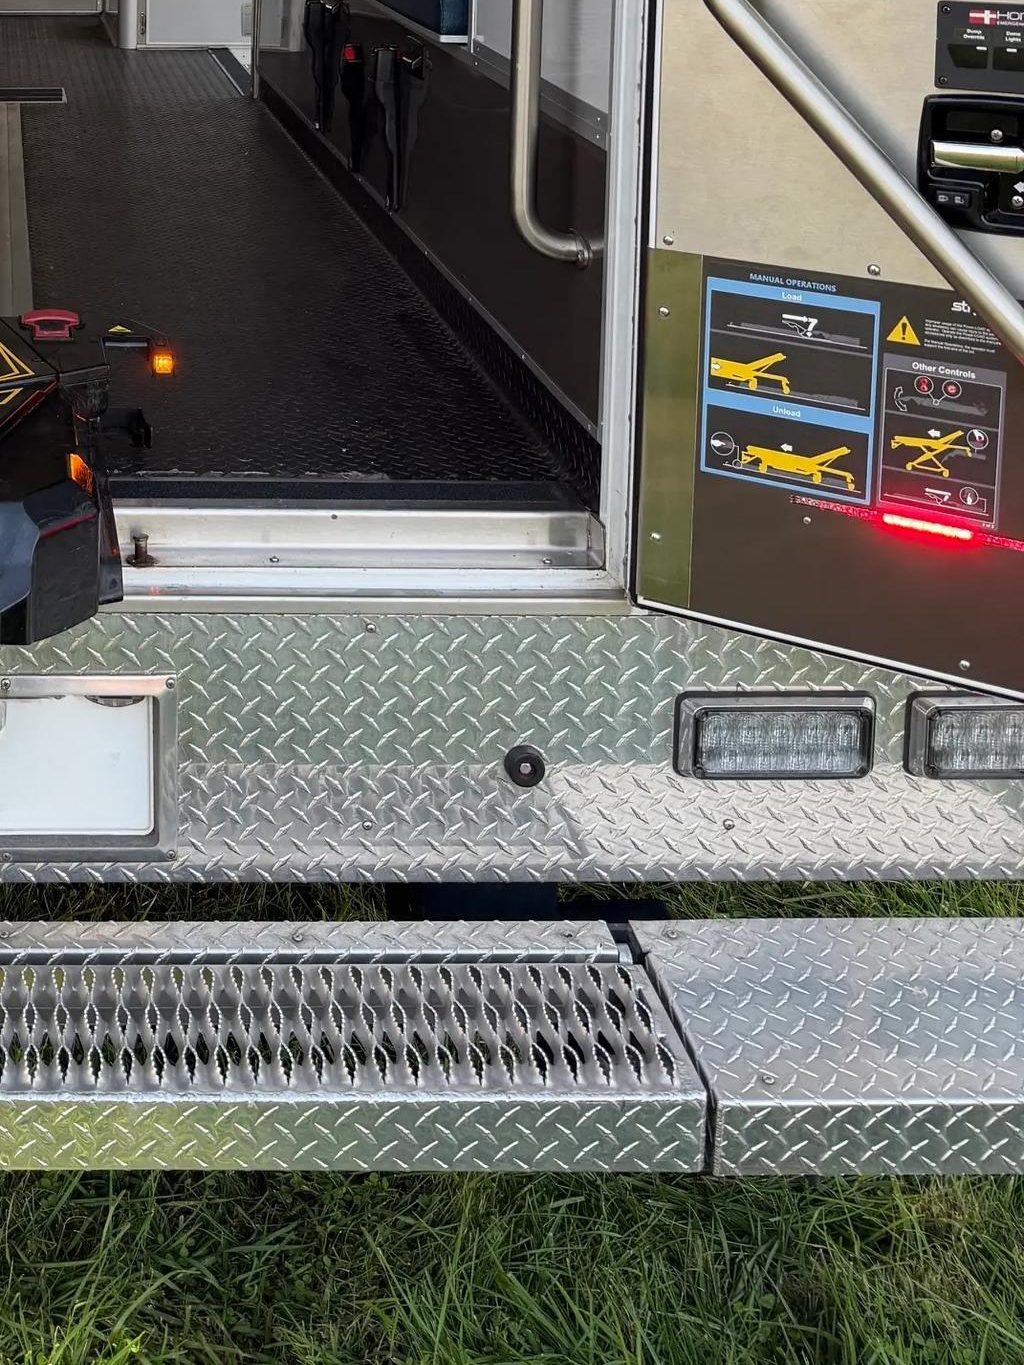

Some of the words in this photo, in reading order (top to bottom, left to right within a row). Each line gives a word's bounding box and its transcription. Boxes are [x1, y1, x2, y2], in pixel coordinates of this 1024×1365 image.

[749, 273, 784, 285] MANUAL
[785, 279, 837, 293] OPERATIONS
[781, 292, 802, 302] Load
[912, 362, 937, 372] Other
[938, 366, 976, 379] Controls
[772, 405, 801, 418] Unload
